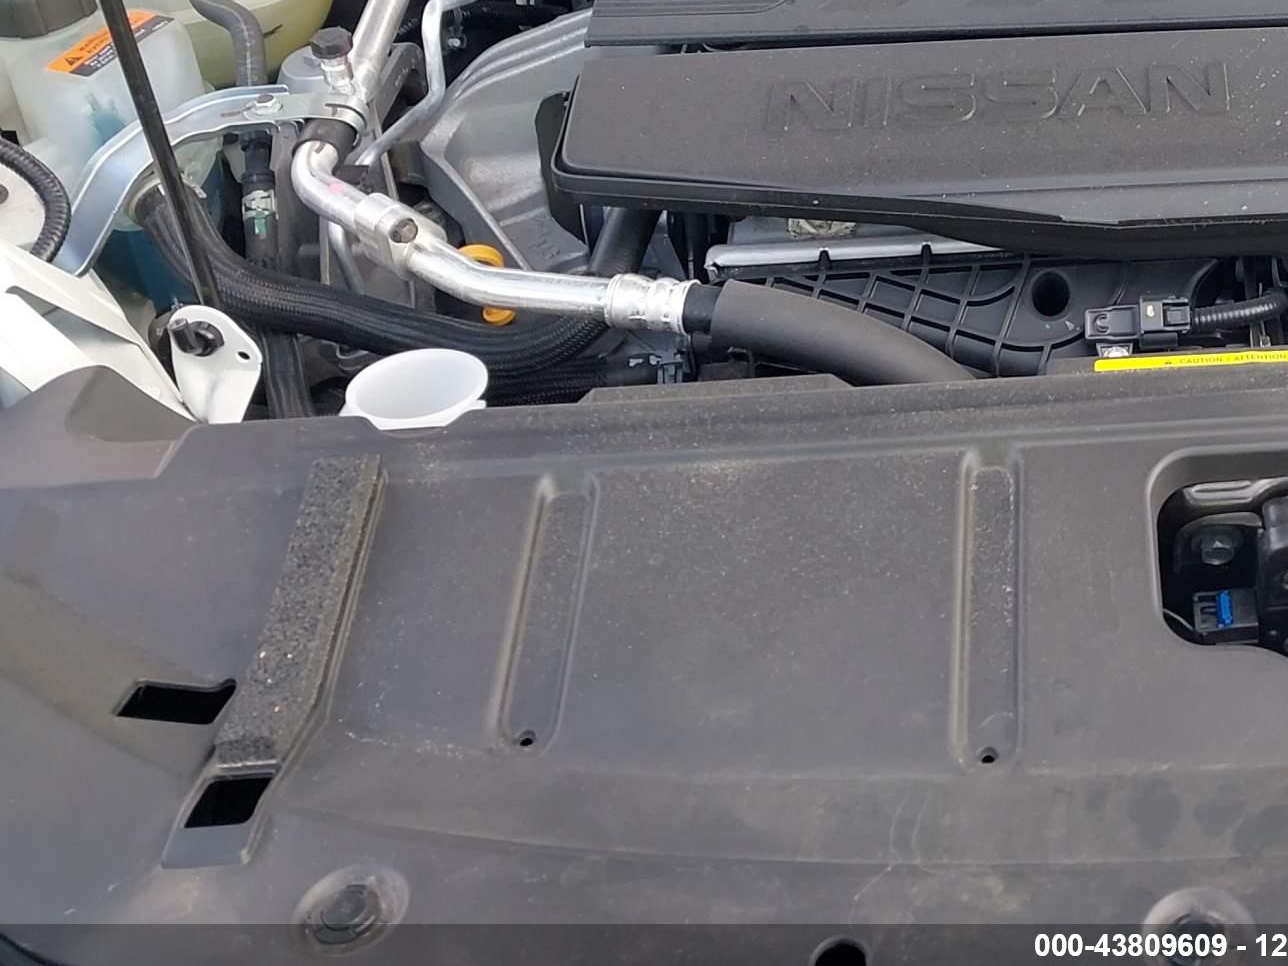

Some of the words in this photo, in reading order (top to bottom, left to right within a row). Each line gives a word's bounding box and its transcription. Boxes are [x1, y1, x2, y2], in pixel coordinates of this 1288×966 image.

[766, 63, 1231, 130] NISSAN
[1179, 357, 1223, 365] CAUTION
[1234, 353, 1288, 362] ATTENTION
